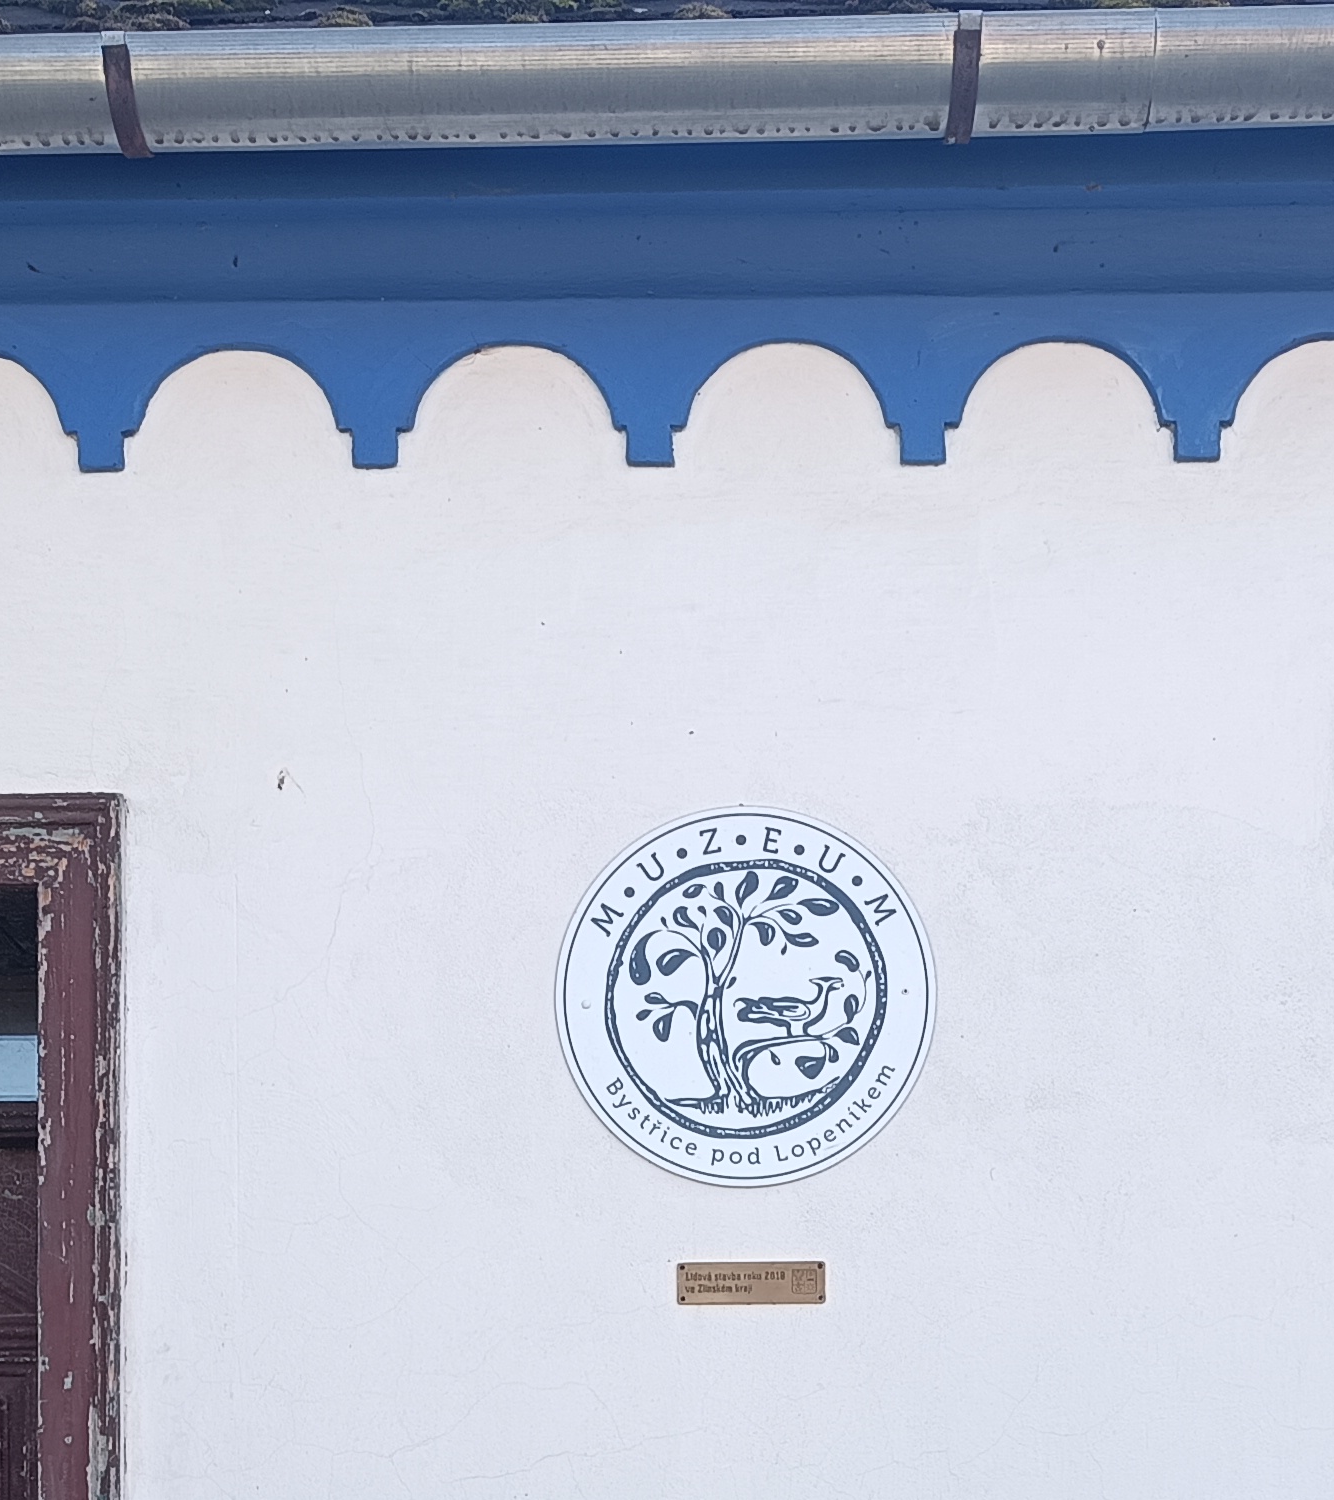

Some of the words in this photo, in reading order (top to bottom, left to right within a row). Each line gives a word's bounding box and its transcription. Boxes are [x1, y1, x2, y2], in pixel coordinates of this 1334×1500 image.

[605, 1076, 698, 1156] Bystřice
[711, 1146, 762, 1166] pod
[774, 1062, 896, 1163] Lopeníkem
[714, 1271, 742, 1281] stavba
[743, 1270, 762, 1281] roku
[685, 1286, 695, 1294] ve
